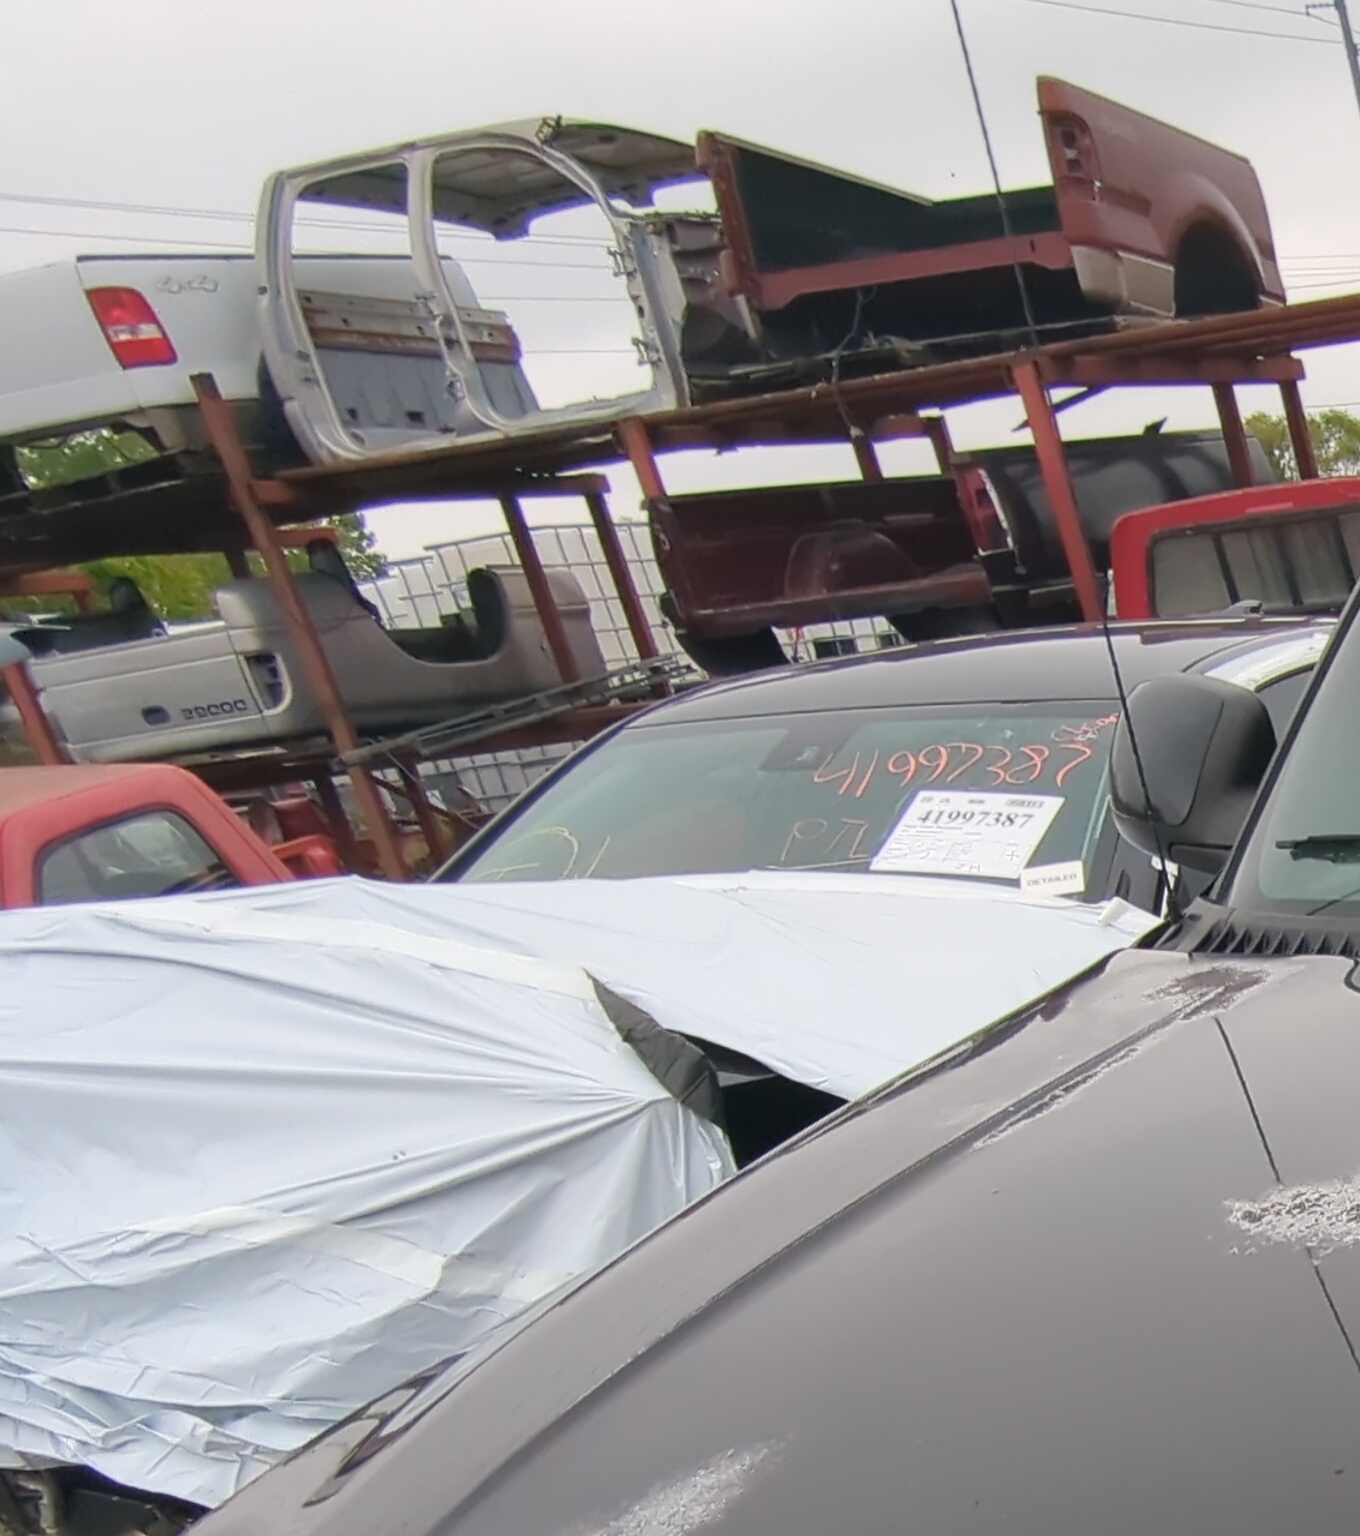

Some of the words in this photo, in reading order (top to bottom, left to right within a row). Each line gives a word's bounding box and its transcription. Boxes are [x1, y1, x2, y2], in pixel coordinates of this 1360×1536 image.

[813, 743, 1092, 798] 41997387
[917, 809, 1034, 829] 41997387
[1026, 872, 1078, 887] DETAILED
